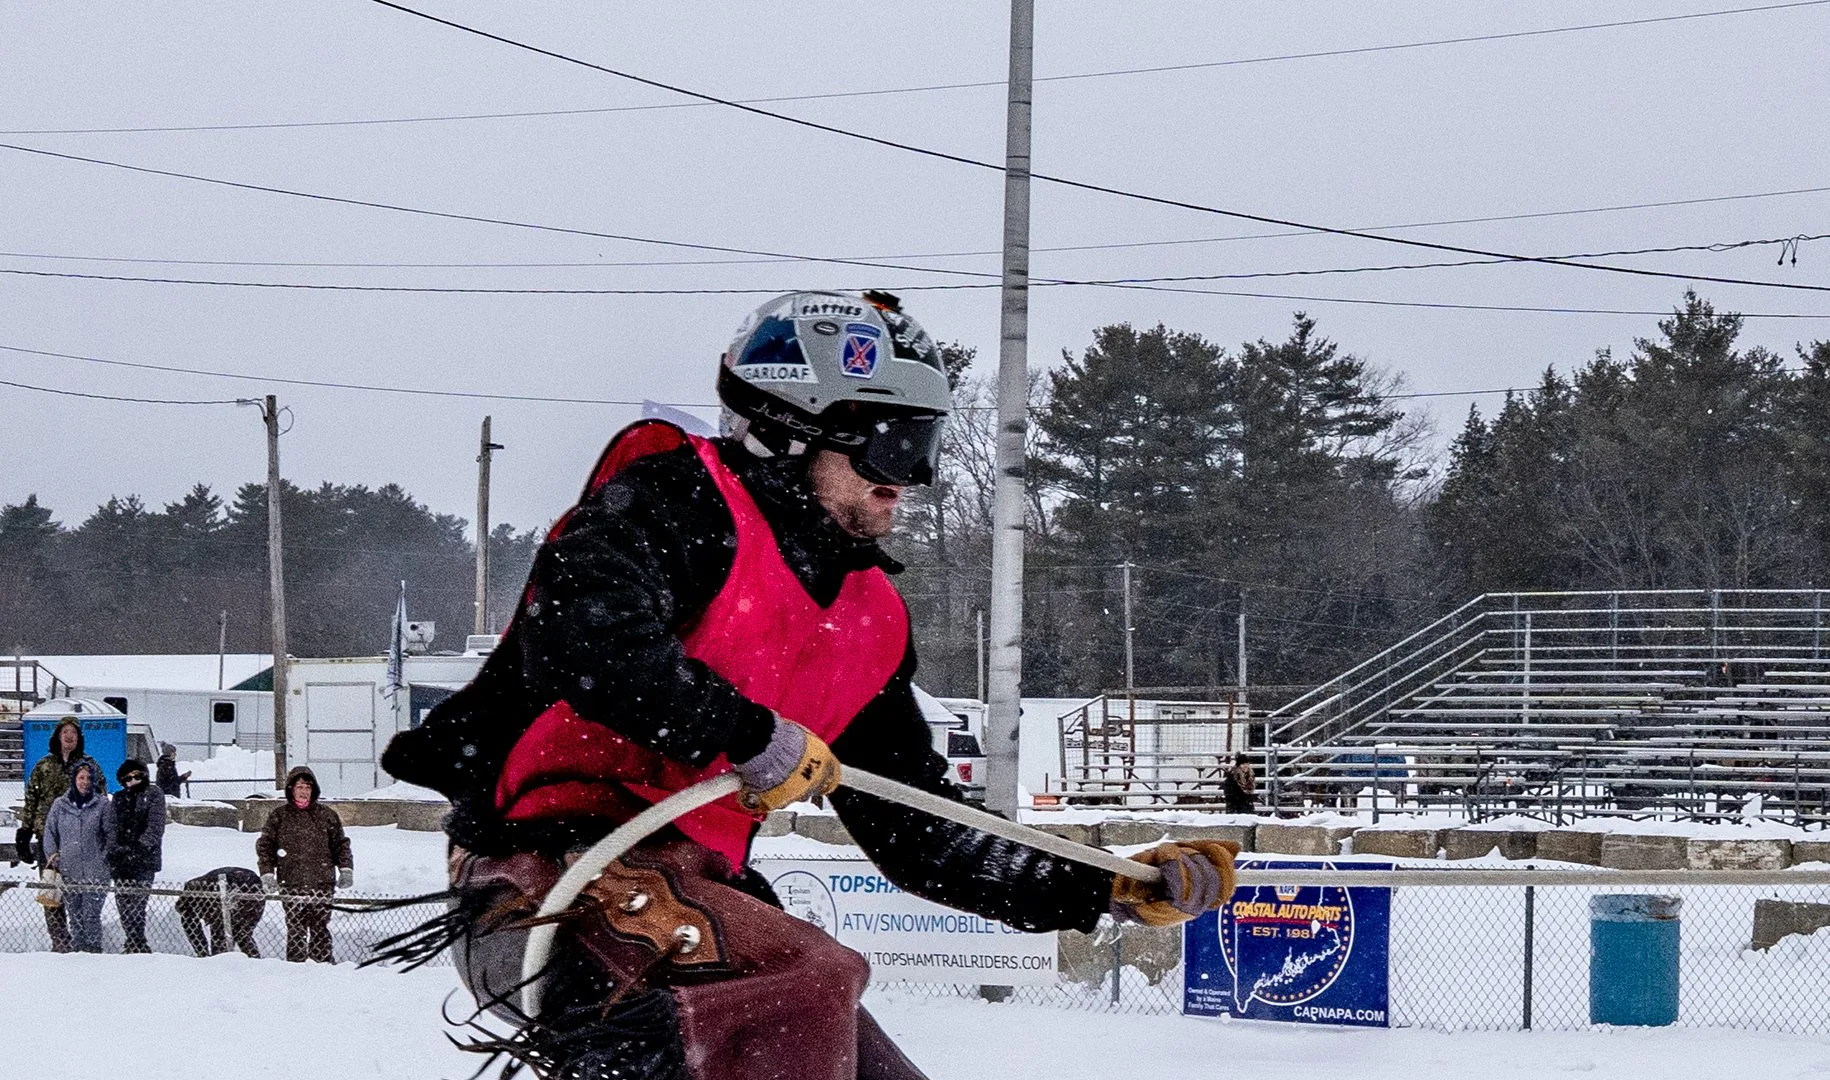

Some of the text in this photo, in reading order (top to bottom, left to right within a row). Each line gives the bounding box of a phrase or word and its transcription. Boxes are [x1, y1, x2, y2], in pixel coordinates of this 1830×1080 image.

[1233, 901, 1341, 921] COASTAL AUTO PARTS
[842, 913, 995, 934] ATV/SNOWMOBILE
[1293, 1006, 1385, 1022] CAPNAPA.COM
